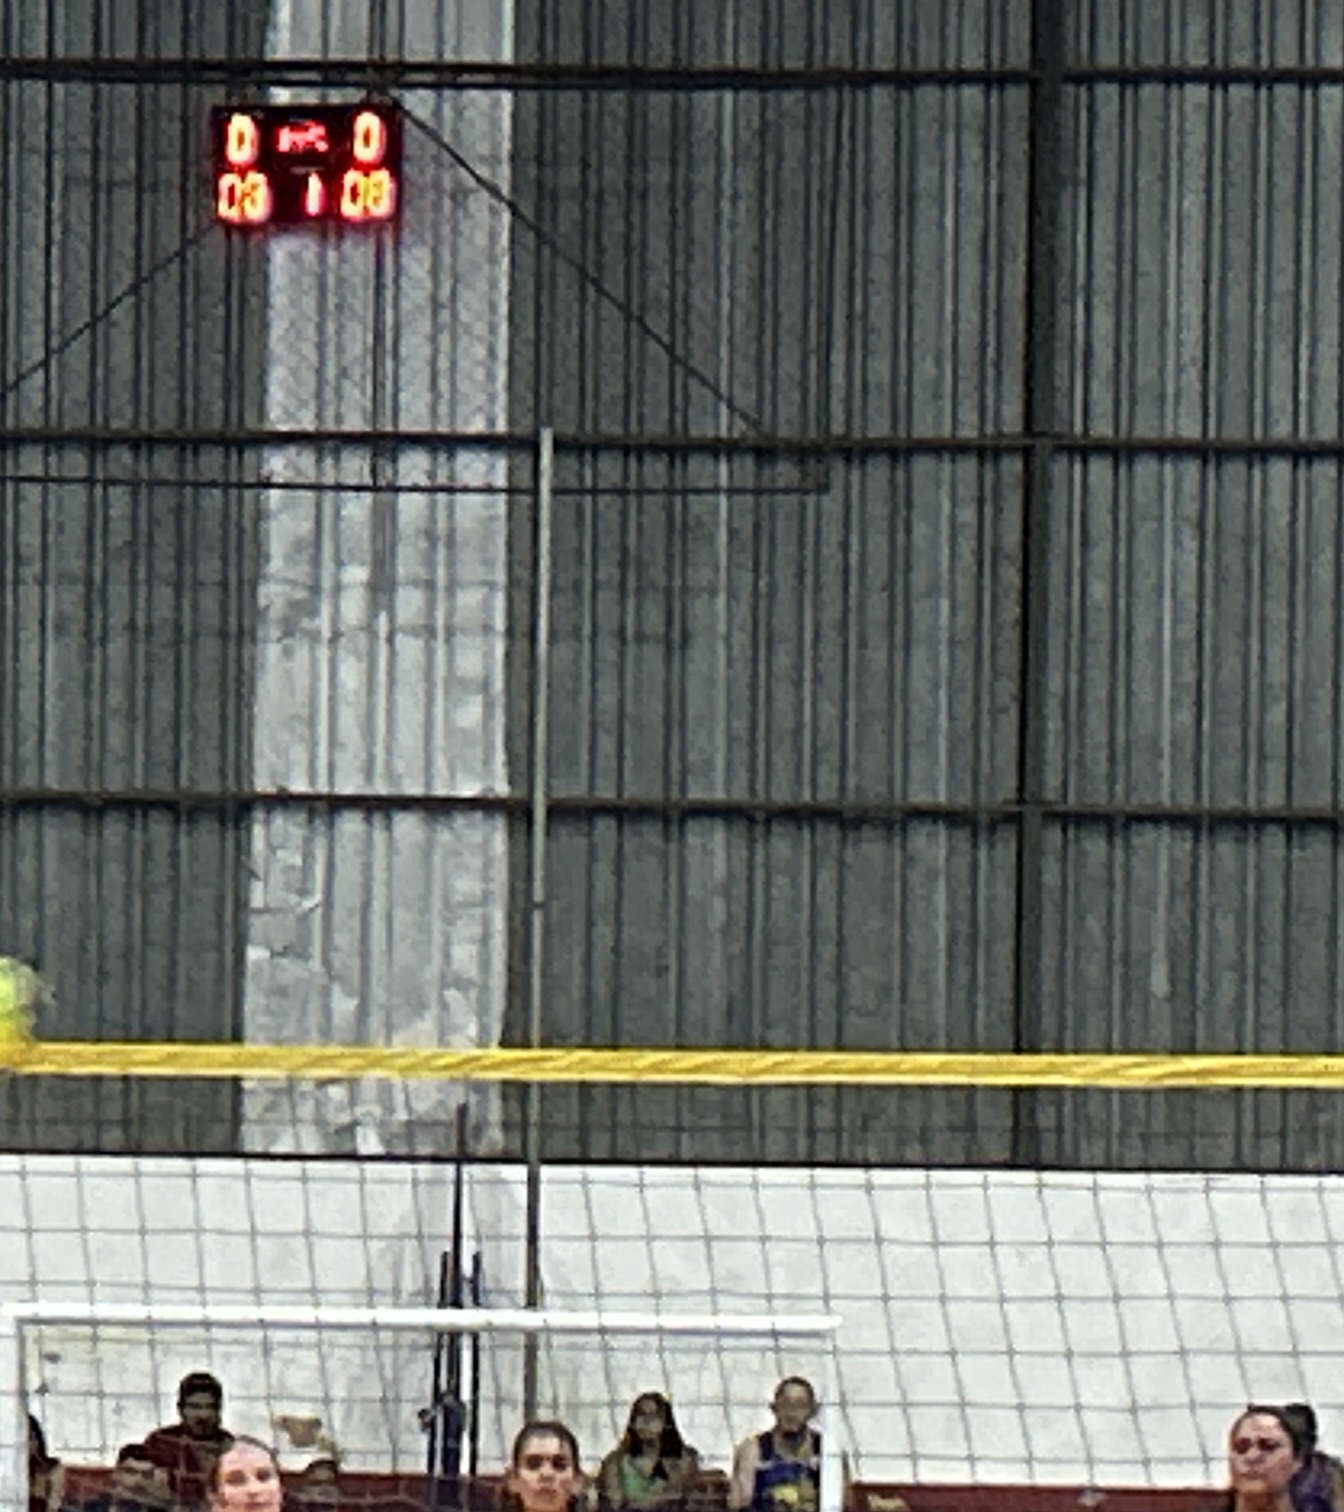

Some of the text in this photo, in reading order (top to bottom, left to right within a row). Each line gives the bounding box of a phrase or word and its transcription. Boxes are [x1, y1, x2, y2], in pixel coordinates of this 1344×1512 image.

[227, 113, 258, 164] 0
[353, 111, 386, 163] 0
[306, 172, 324, 216] 1
